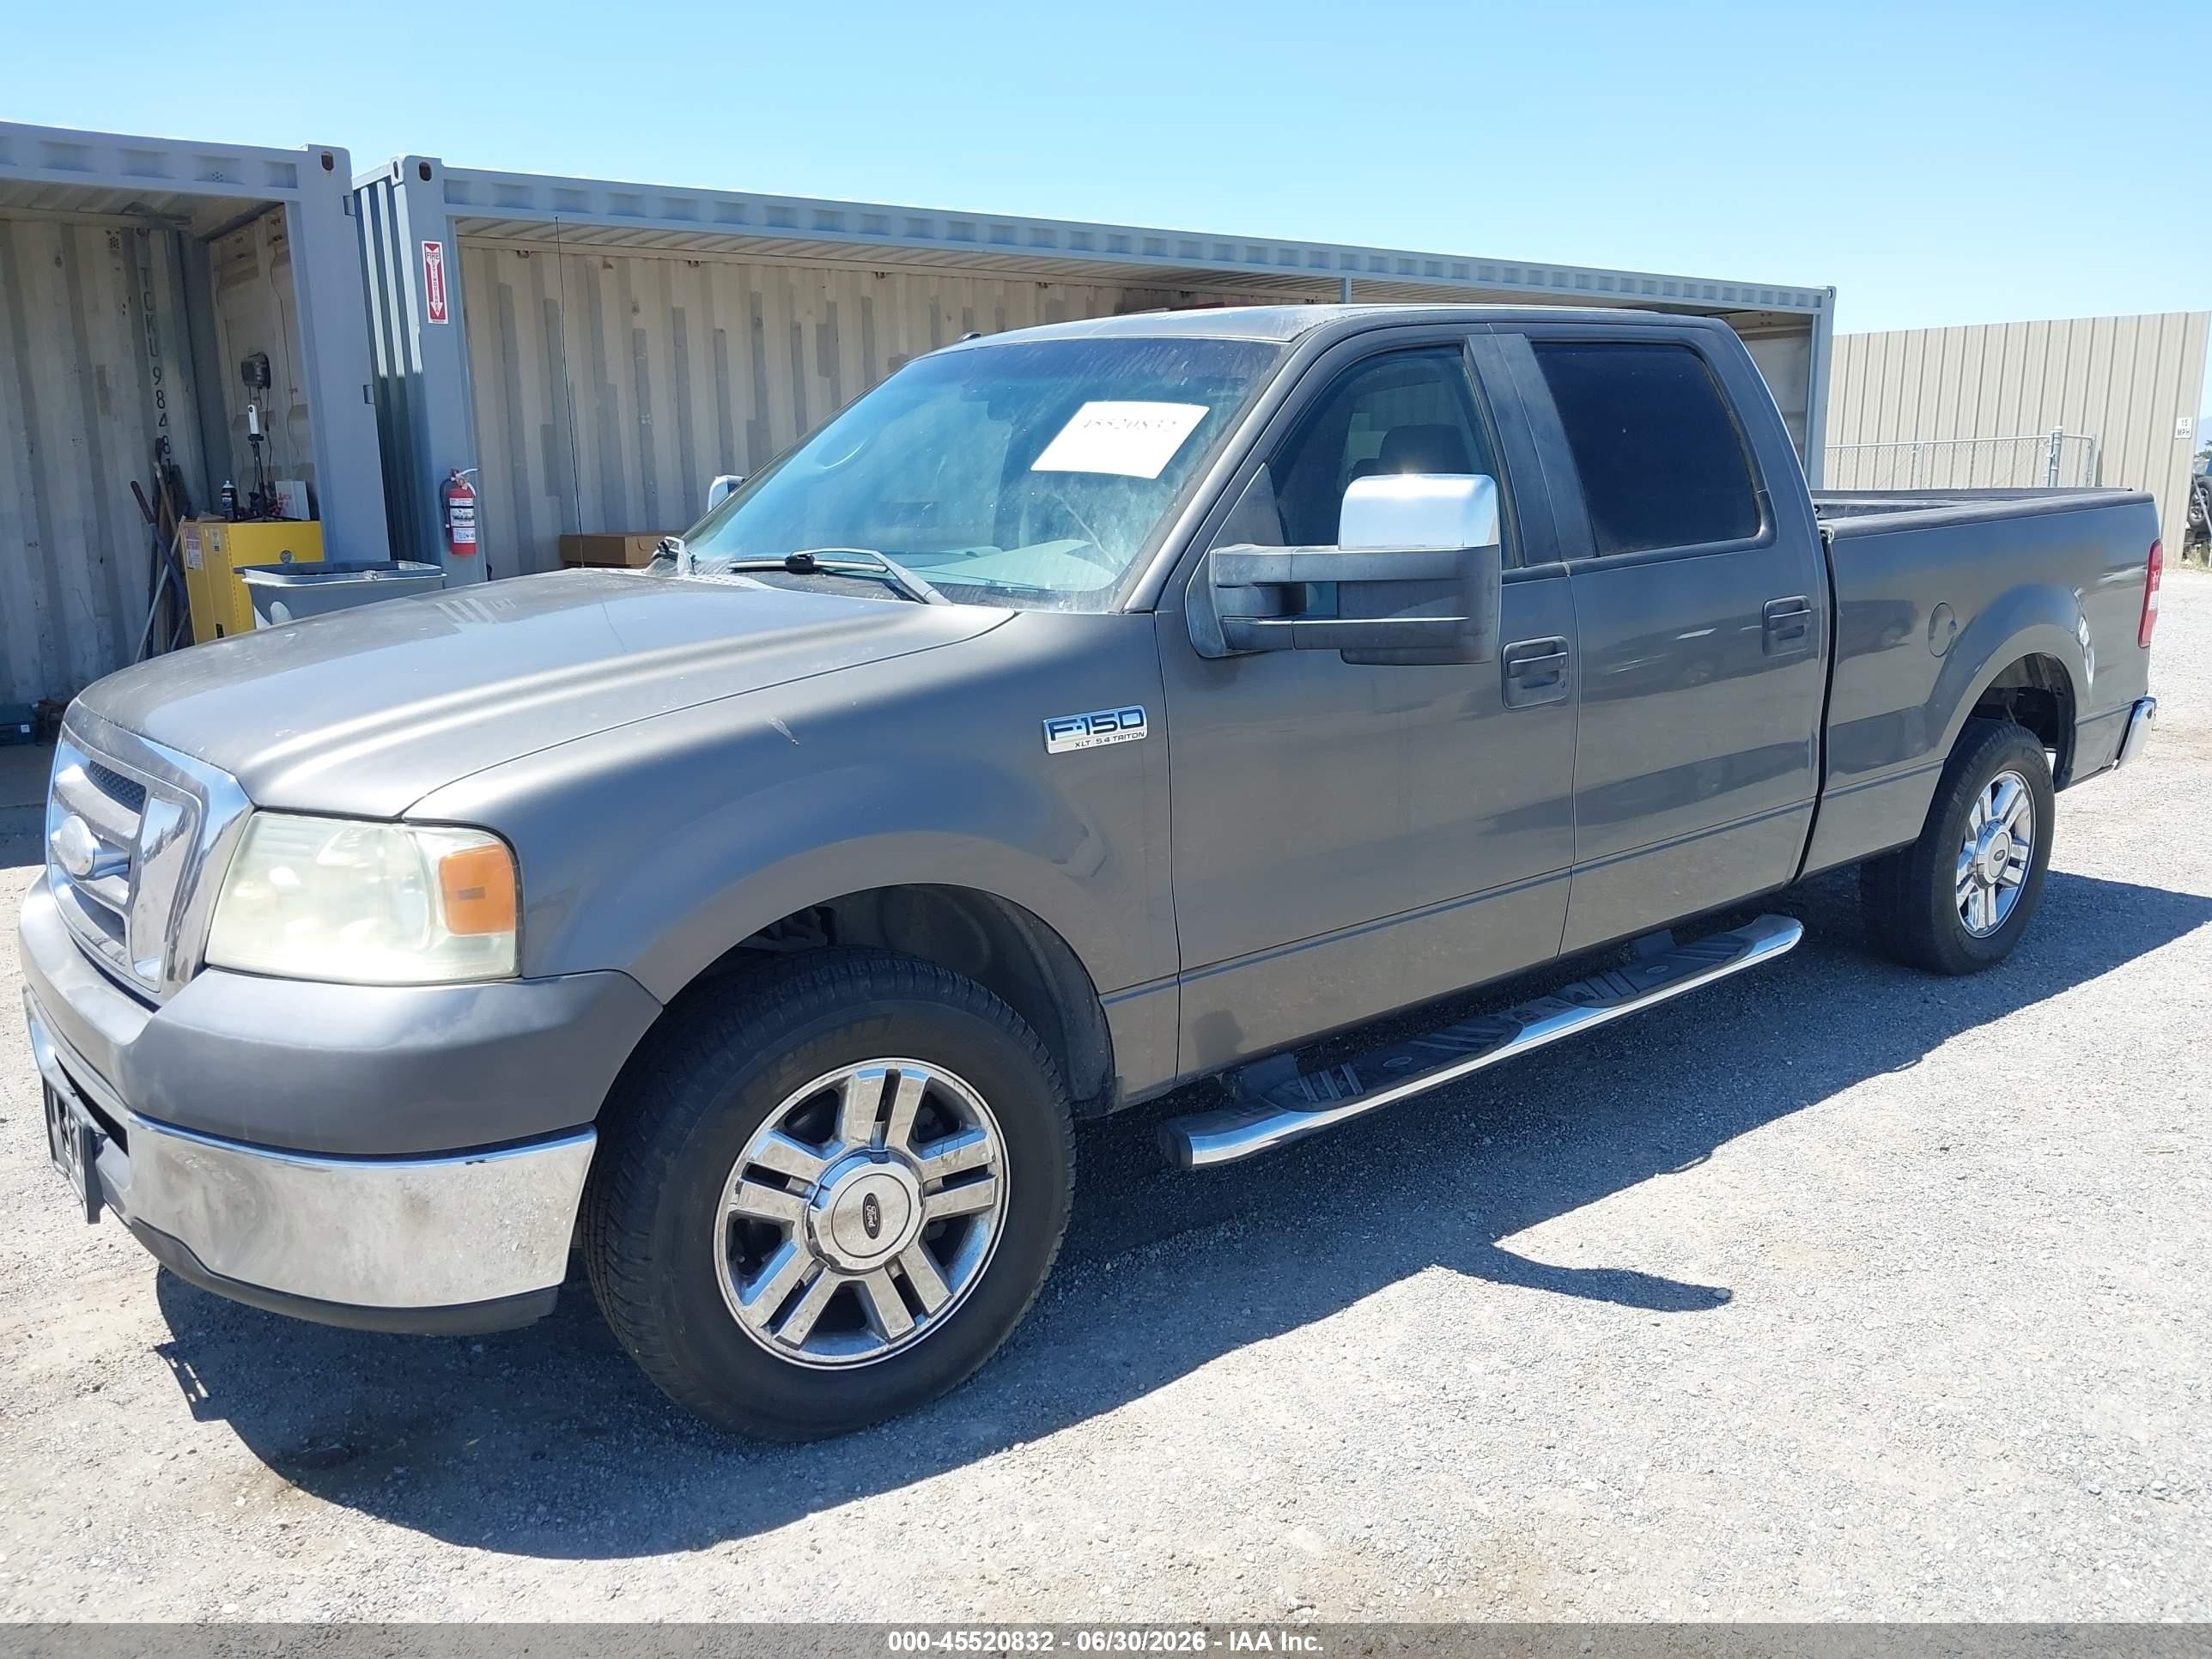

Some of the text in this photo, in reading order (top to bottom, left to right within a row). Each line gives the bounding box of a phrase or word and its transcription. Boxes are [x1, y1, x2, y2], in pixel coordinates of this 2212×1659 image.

[1048, 709, 1145, 741] F-150
[1074, 732, 1145, 749] XLT 5.4 TRITON
[866, 1205, 878, 1228] Ford
